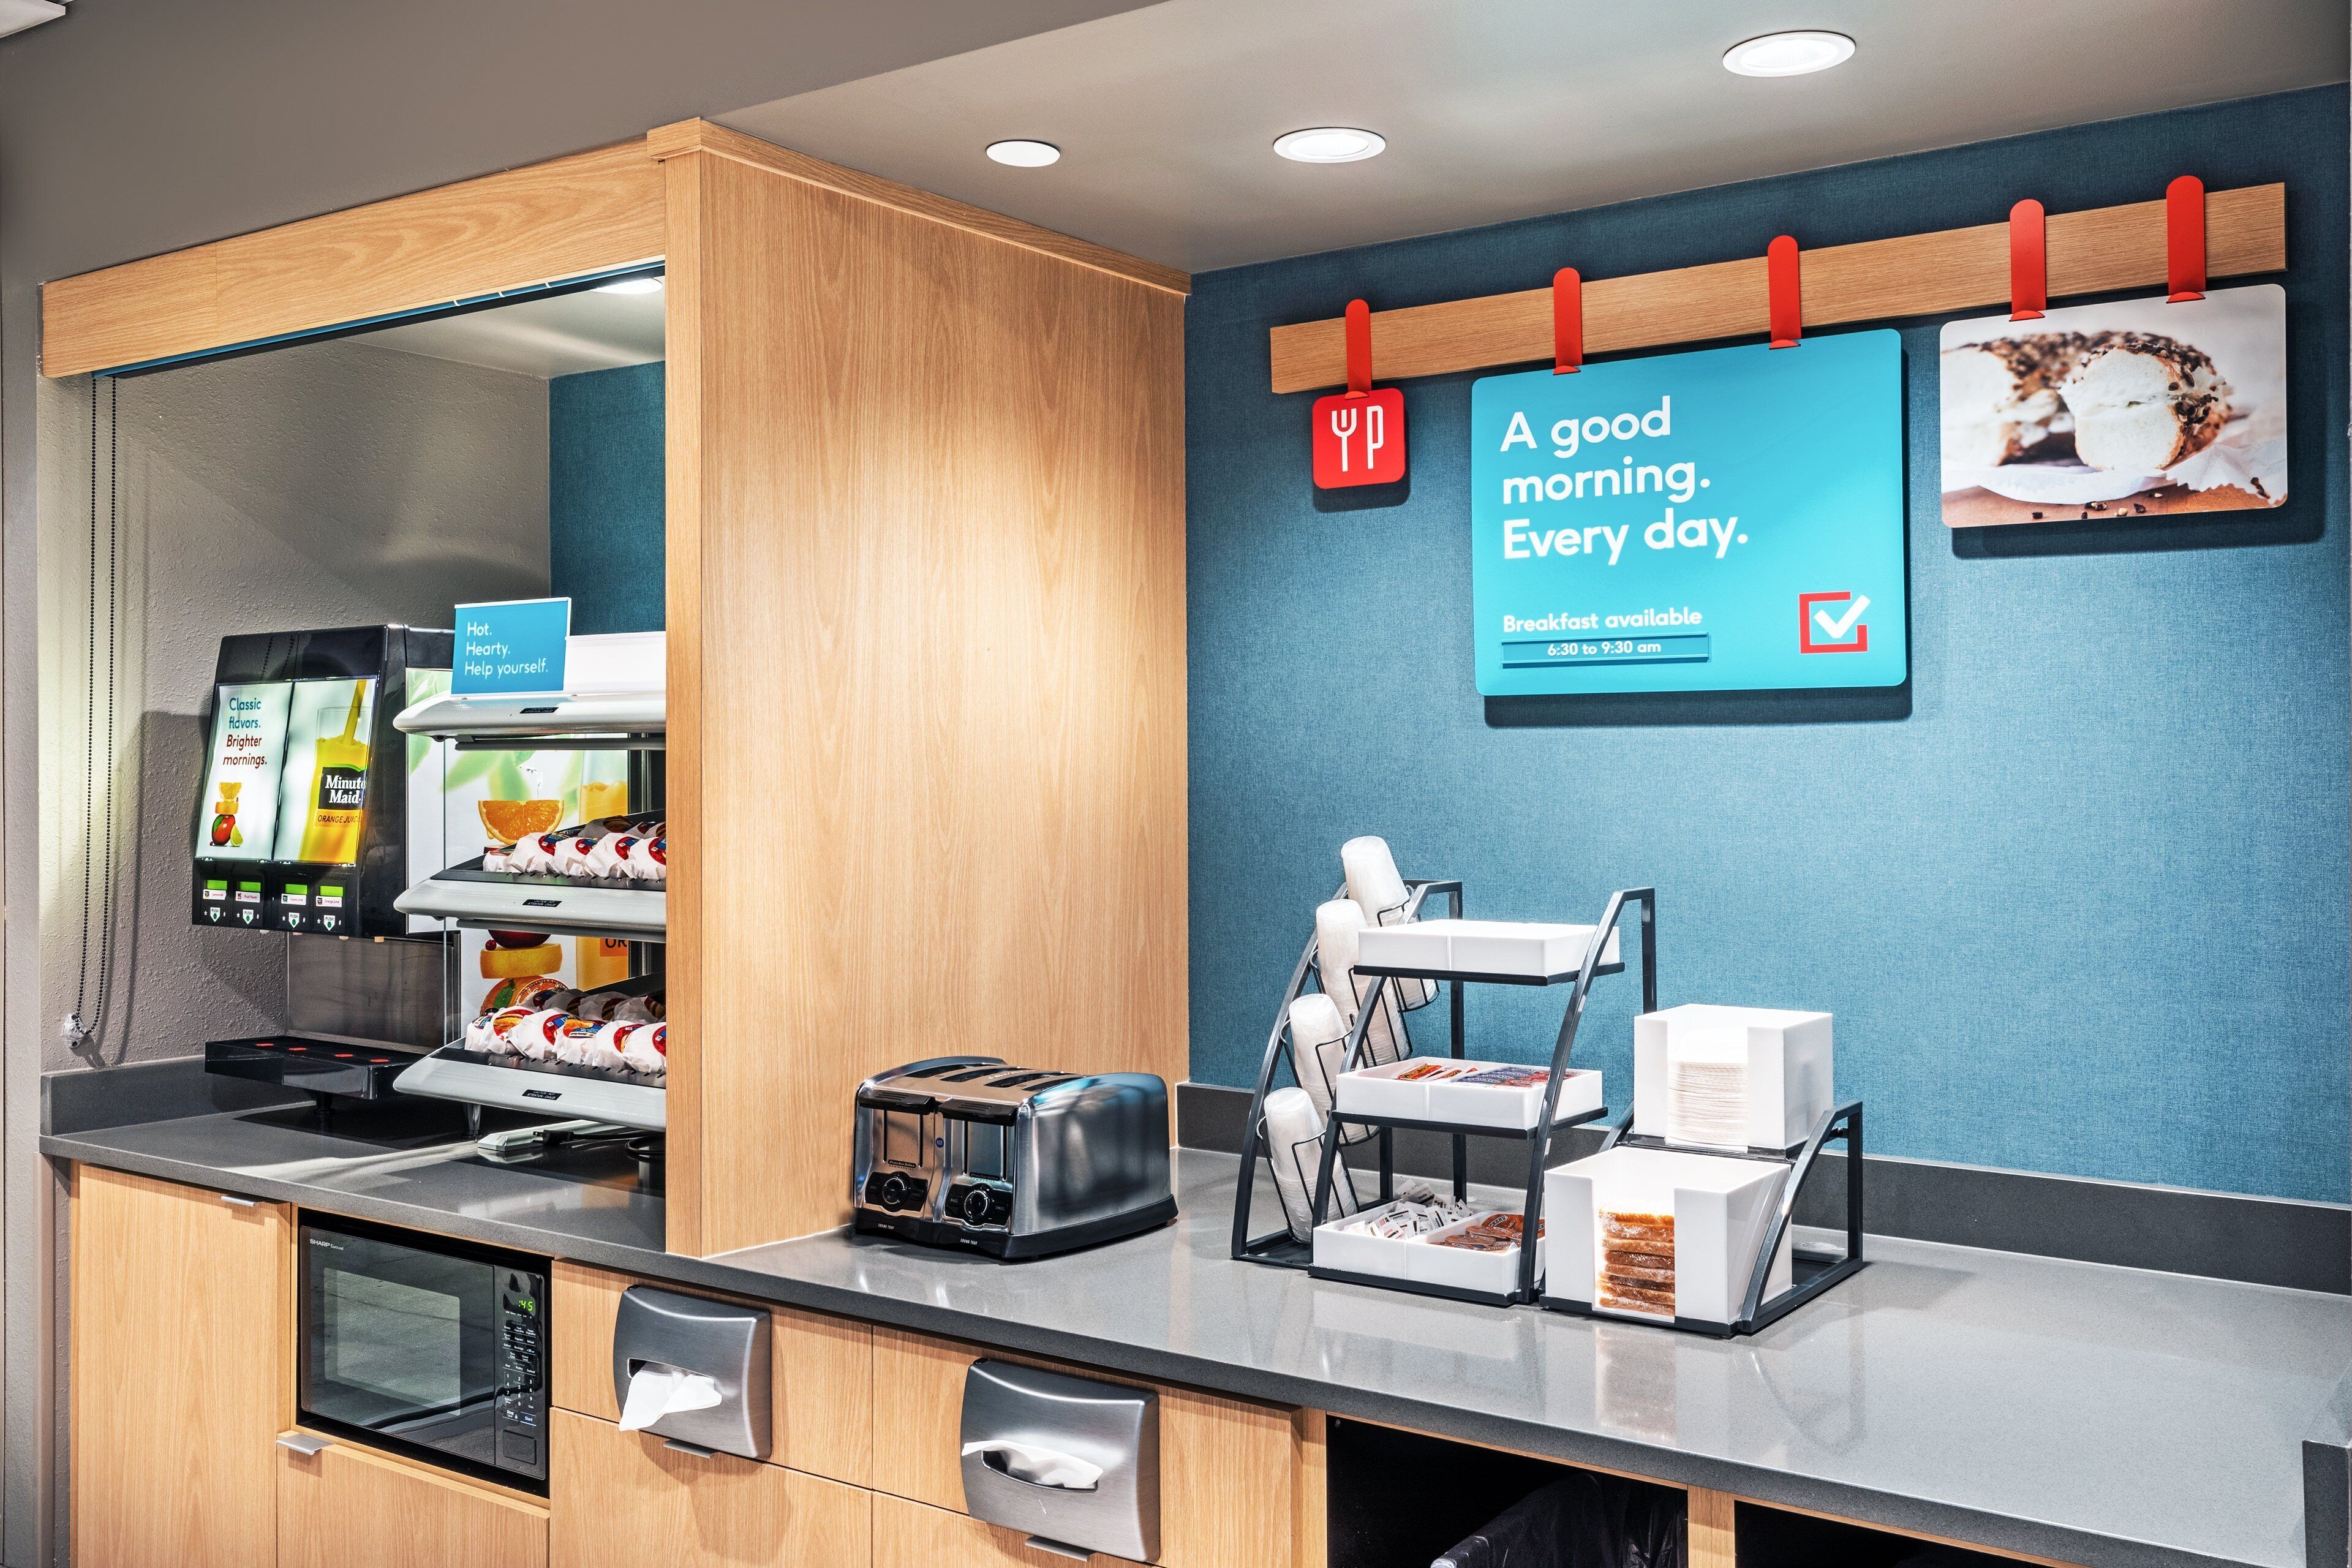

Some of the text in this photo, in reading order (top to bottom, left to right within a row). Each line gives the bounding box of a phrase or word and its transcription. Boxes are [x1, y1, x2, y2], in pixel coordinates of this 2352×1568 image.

[1500, 395, 1670, 458] A good
[1503, 456, 1710, 504] morning.
[1504, 507, 1748, 565] Every day.
[1503, 606, 1703, 633] Breakfast available
[467, 621, 492, 636] Hot.
[466, 641, 511, 659] Hearty.
[1547, 640, 1662, 657] 6:30 to 9:30 am
[464, 657, 548, 680] Help yourself.
[229, 697, 262, 710] Classic
[228, 715, 261, 729] flavors.
[226, 734, 262, 752] Brighter
[222, 753, 268, 769] mornings.
[329, 789, 360, 804] Maid
[317, 815, 344, 823] ORANGE
[309, 1238, 330, 1248] SHARP
